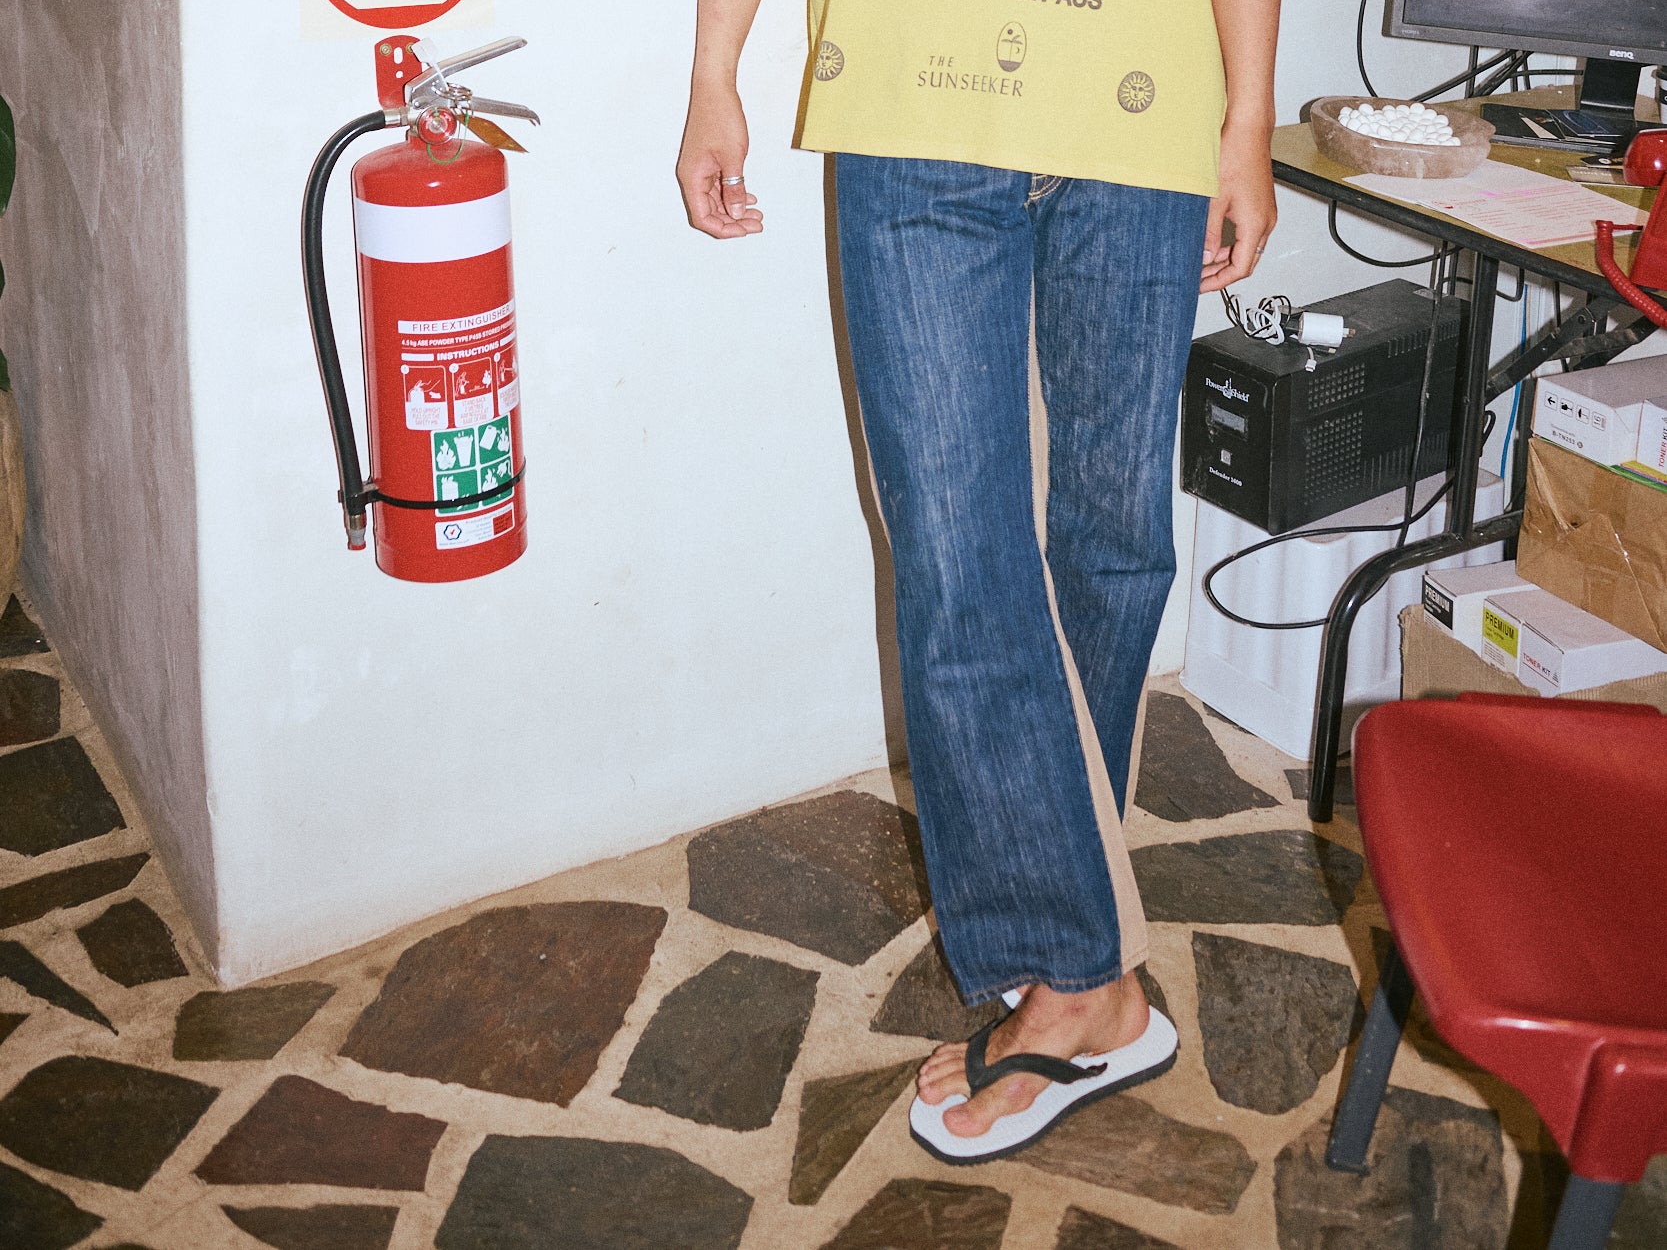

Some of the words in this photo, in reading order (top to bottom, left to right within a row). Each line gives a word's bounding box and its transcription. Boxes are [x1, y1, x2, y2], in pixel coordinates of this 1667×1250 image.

[929, 56, 954, 67] THE
[1609, 50, 1634, 60] BenQ
[917, 71, 1023, 97] SUNSEEKER
[412, 323, 438, 332] FIRE
[442, 305, 510, 331] EXTINGUISHER
[429, 337, 454, 346] POWDER
[455, 335, 468, 343] TYPE
[437, 341, 499, 361] INSTRUCTIONS
[1209, 467, 1230, 481] Defender
[1486, 612, 1514, 639] PREMIUM
[1523, 652, 1541, 669] TONER
[1542, 667, 1551, 676] KIT
